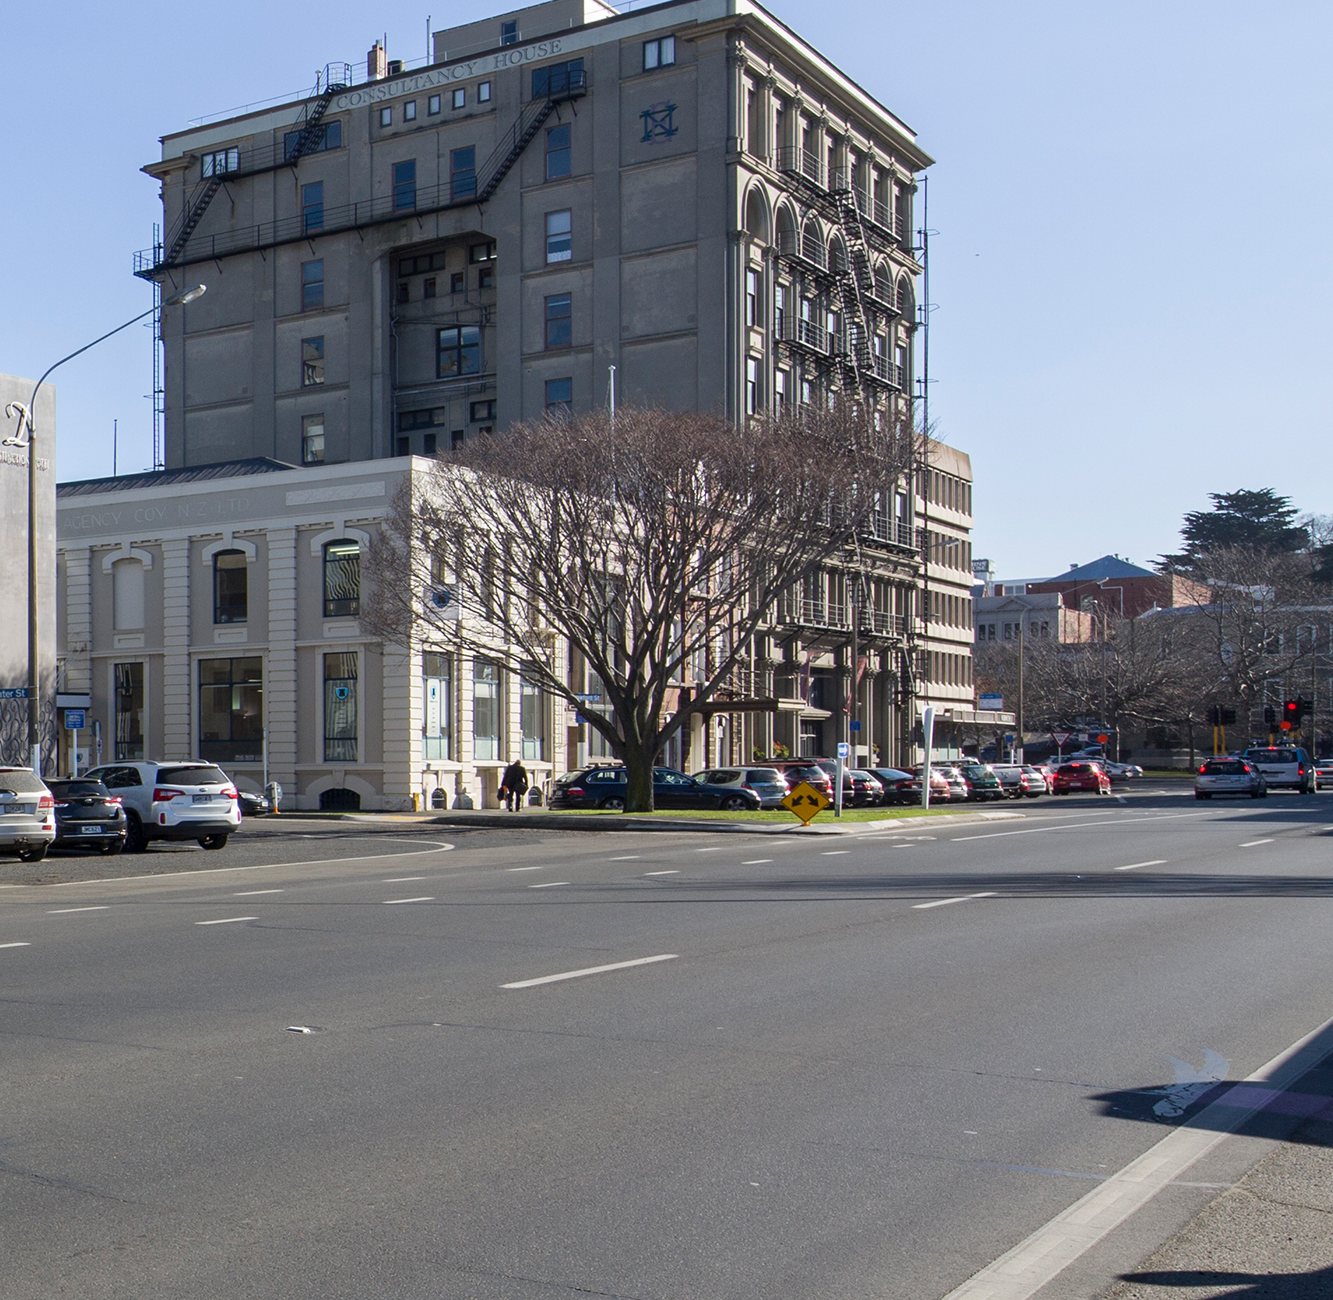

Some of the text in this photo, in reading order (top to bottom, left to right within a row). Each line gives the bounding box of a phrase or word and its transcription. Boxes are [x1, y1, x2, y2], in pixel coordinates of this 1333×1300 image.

[337, 39, 562, 109] CONSULTANCY HOUSE
[63, 511, 122, 531] AGENCY
[15, 688, 26, 698] St
